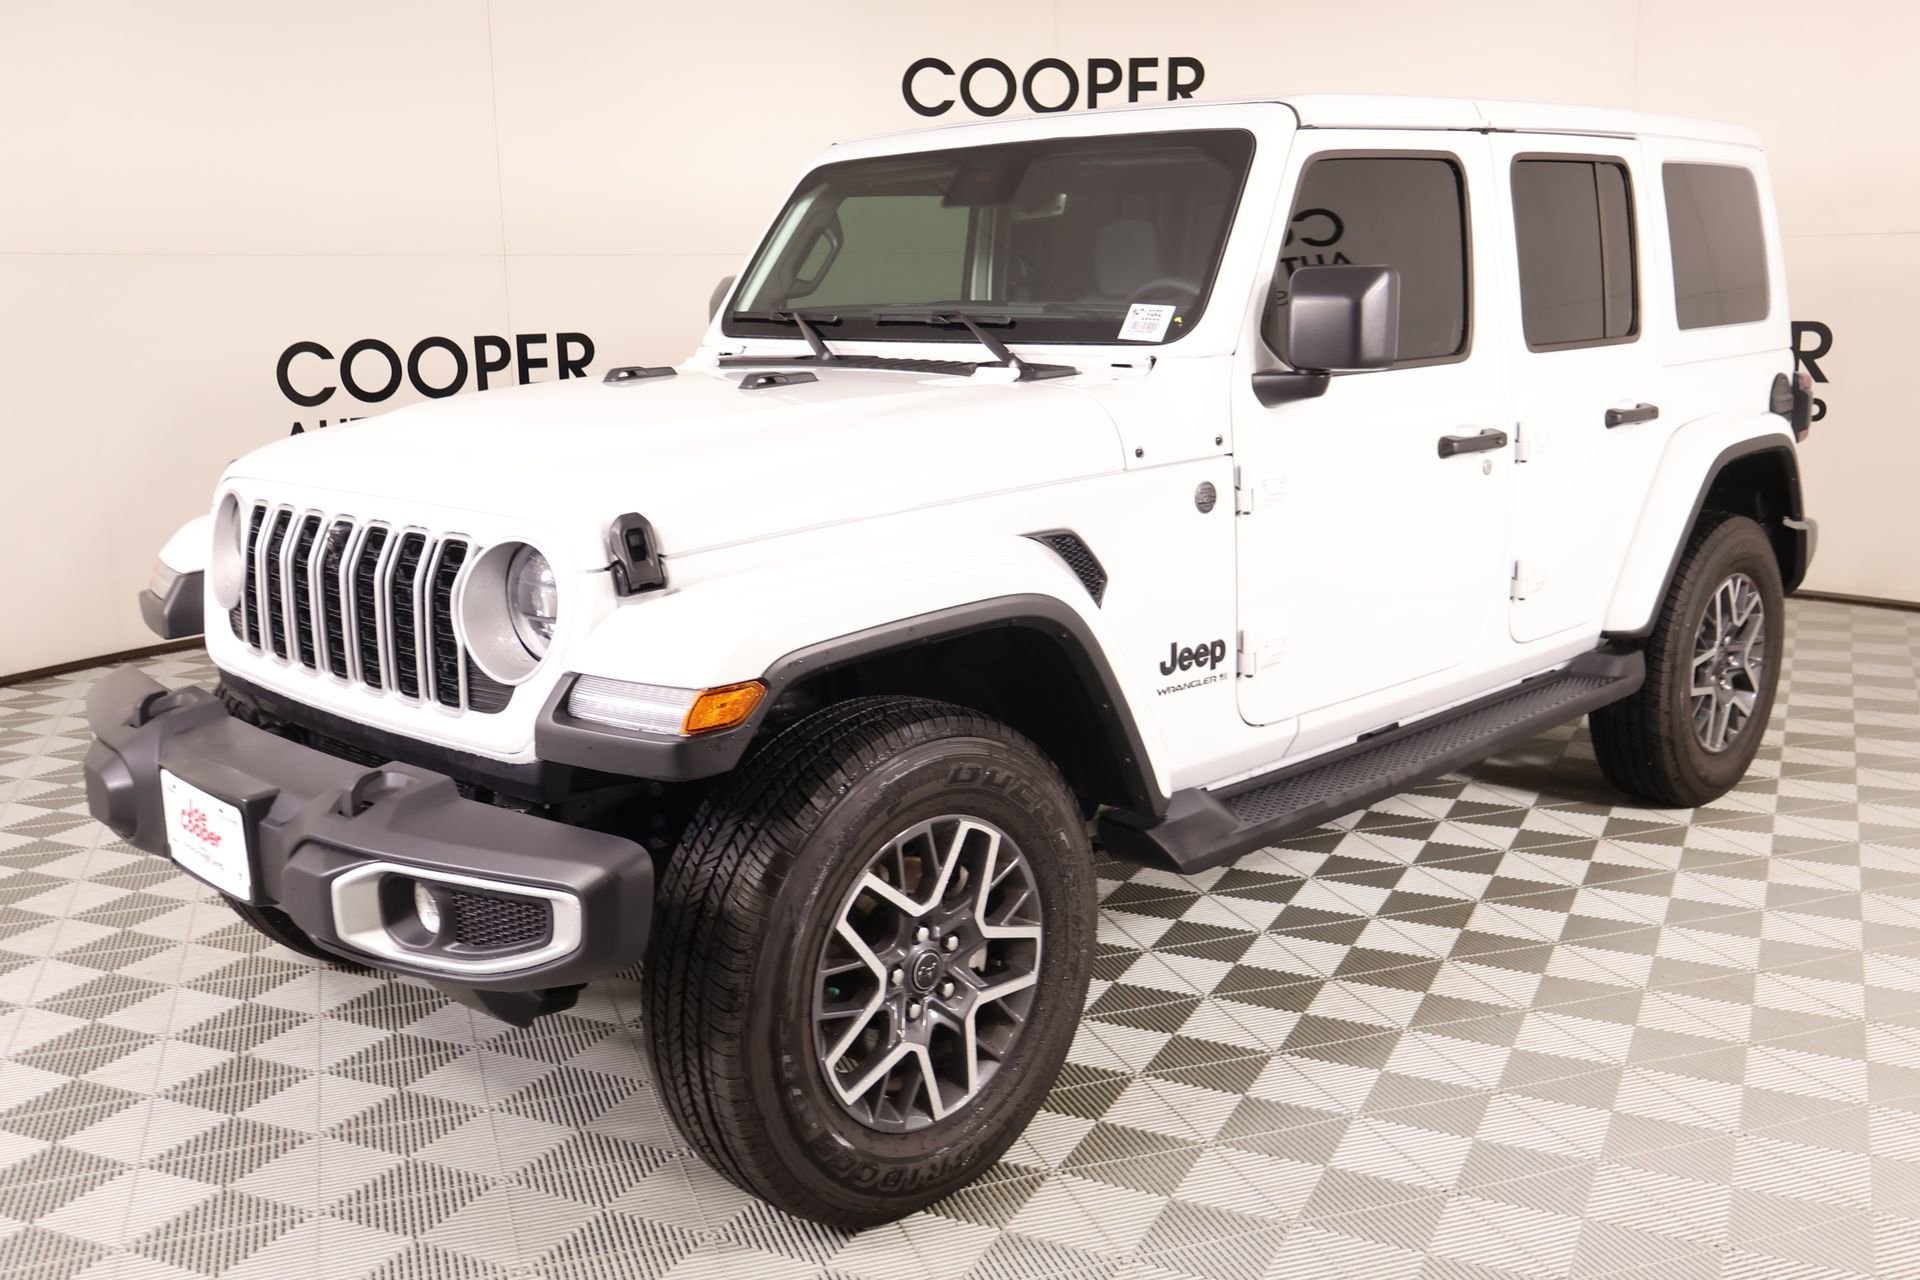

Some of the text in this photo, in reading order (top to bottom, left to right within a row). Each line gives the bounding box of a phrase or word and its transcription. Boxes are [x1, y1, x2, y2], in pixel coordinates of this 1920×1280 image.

[902, 56, 1205, 117] COOPER
[277, 332, 596, 407] COOPER
[1160, 639, 1226, 676] Jeep
[1157, 675, 1217, 696] WRANGLER
